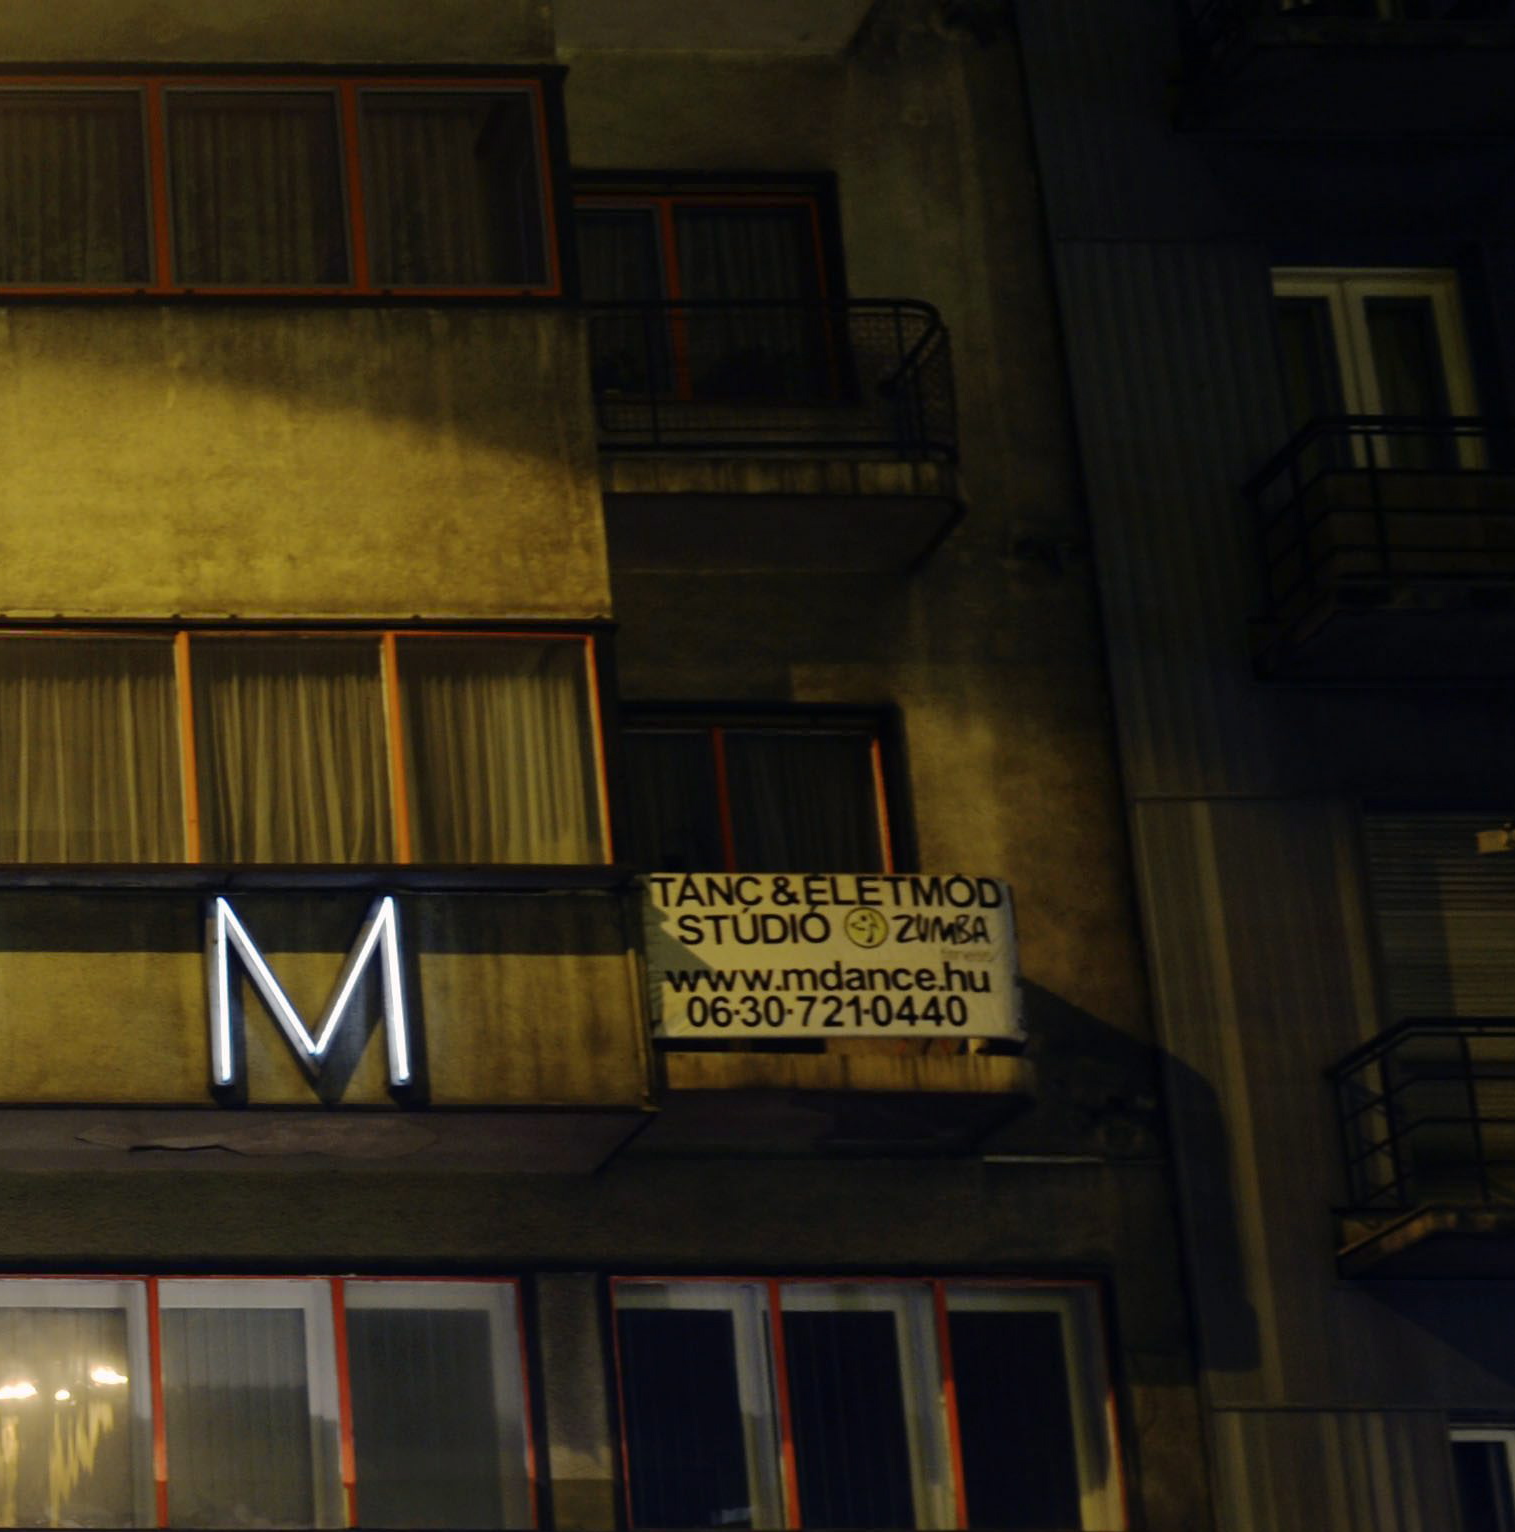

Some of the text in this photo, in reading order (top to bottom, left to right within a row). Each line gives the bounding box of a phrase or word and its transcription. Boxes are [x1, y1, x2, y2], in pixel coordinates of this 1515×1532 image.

[678, 905, 831, 945] STÚDIÓ
[892, 914, 992, 945] ZUMBA
[665, 960, 992, 993] www.mdance.hu
